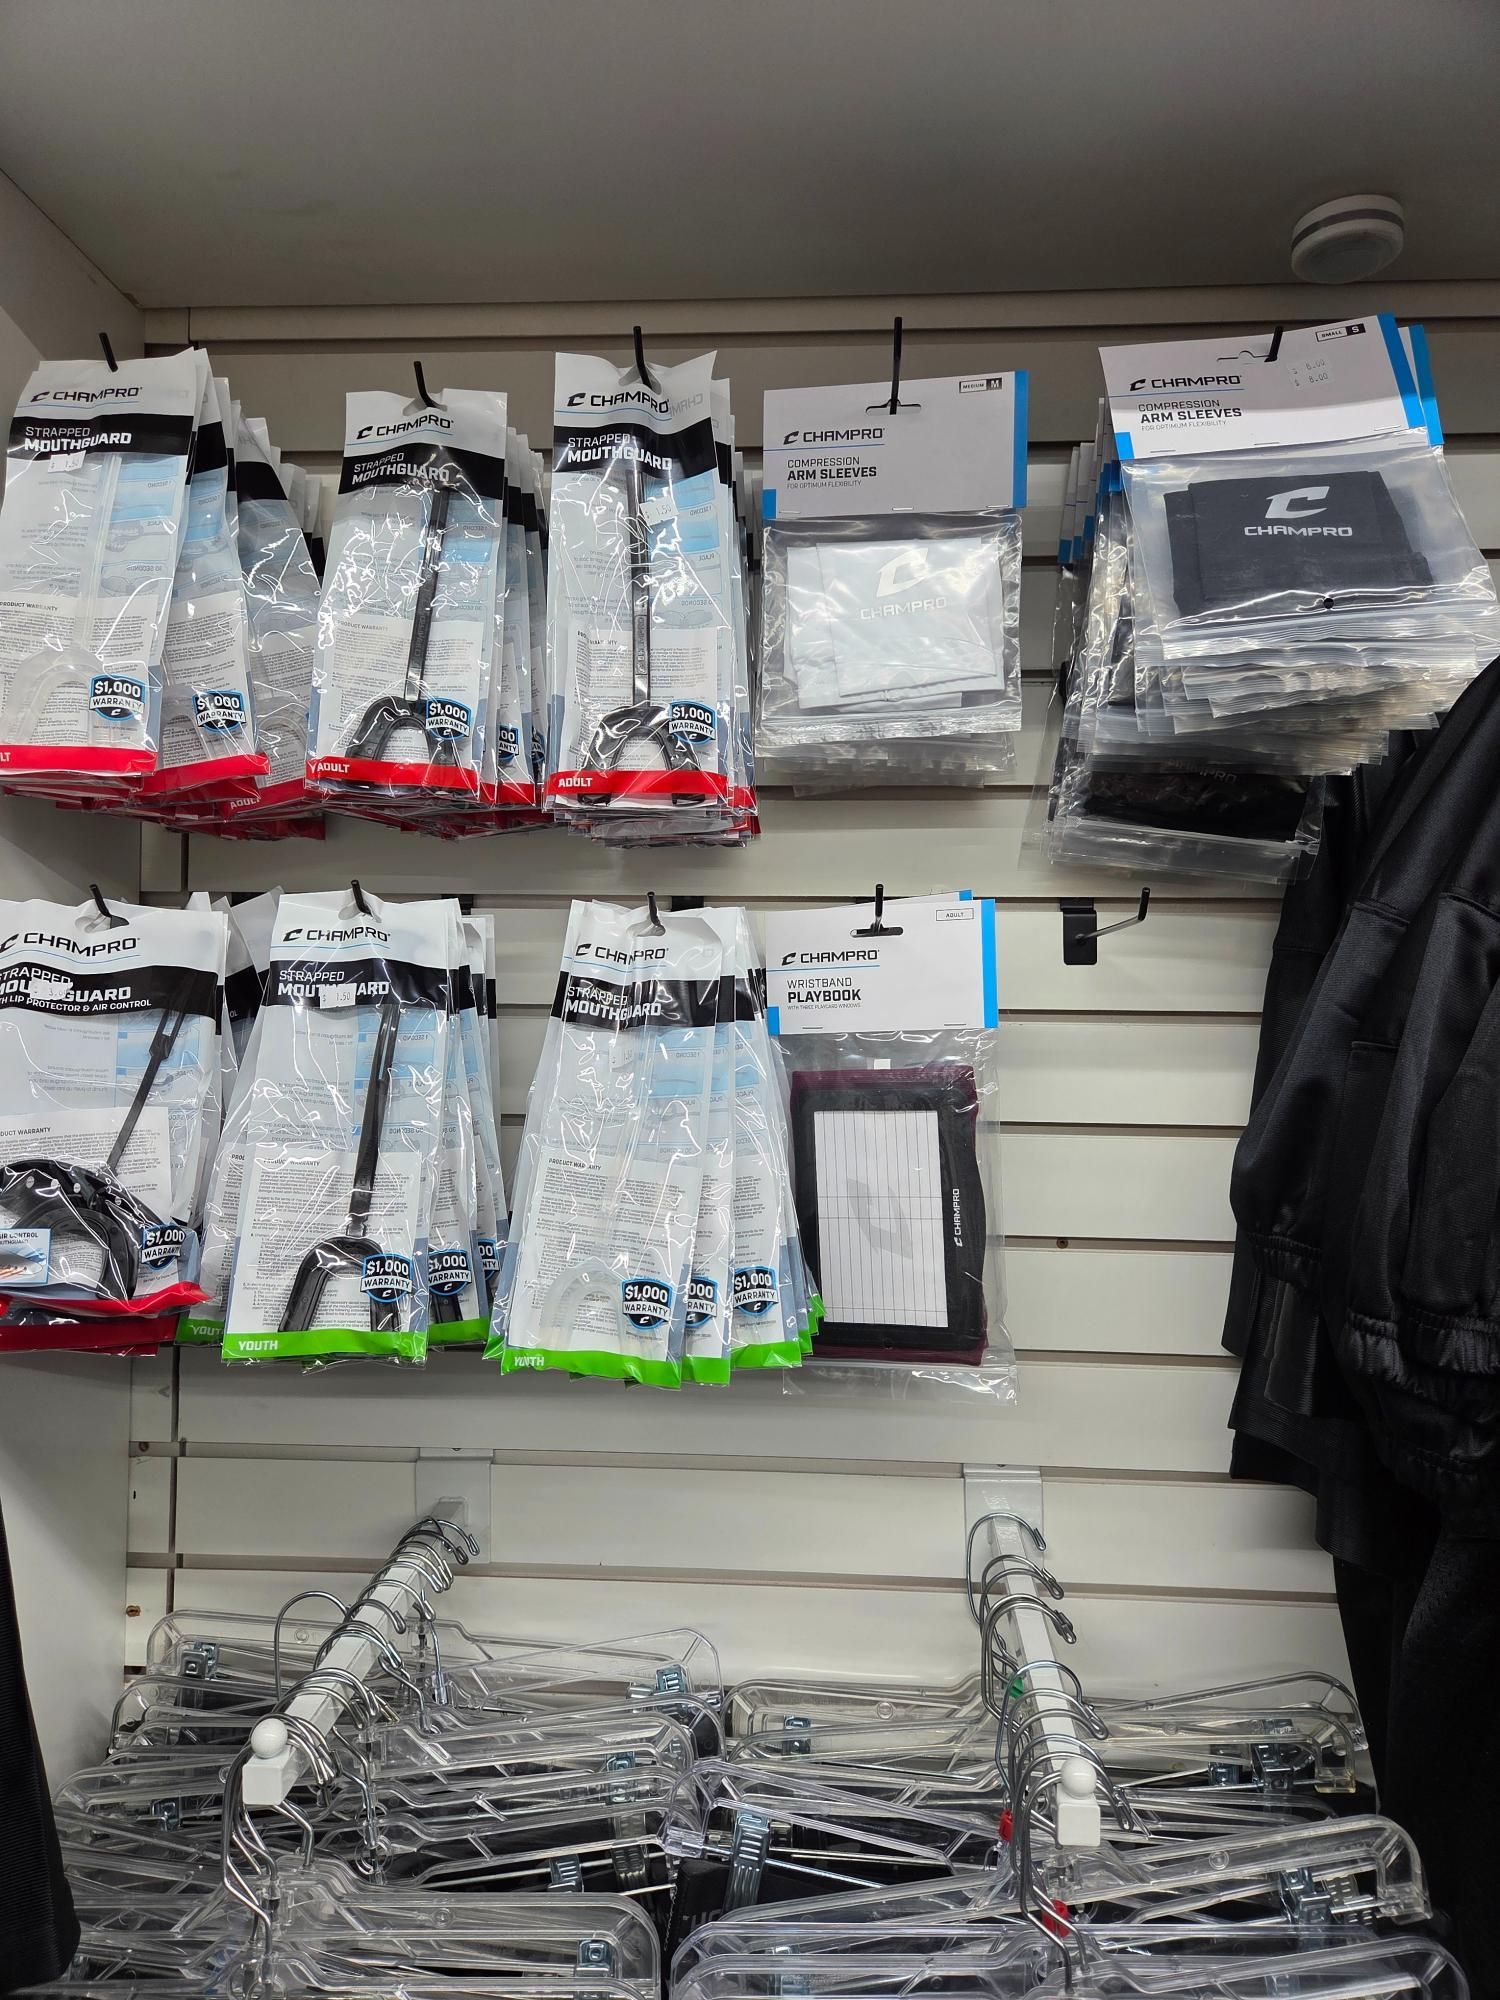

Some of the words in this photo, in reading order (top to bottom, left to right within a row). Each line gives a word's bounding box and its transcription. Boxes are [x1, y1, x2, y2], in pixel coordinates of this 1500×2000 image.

[1321, 330, 1343, 338] SMALL
[990, 380, 999, 388] M
[1151, 375, 1241, 389] CHAMPRO
[52, 387, 139, 402] CHAMPRO
[590, 391, 669, 414] CHAMPRO
[1138, 400, 1220, 412] COMPRESSION
[1140, 411, 1174, 424] ARM
[1177, 408, 1242, 420] SLEEVES
[25, 426, 91, 438] STRAPPED
[376, 414, 451, 436] CHAMPRO
[1156, 422, 1186, 430] OPTIMUM
[1188, 420, 1226, 428] FLEXIBILITY
[24, 431, 132, 452] MOUTHGUARD
[568, 433, 631, 448] STRAPPED
[803, 428, 884, 443] CHAMPRO
[354, 452, 405, 473] STRAPPED
[568, 446, 673, 470] MOUTHGUARD
[787, 456, 860, 468] COMPRESSION
[352, 463, 450, 485] MOUTHGUARD
[787, 469, 816, 481] ARM
[820, 466, 877, 479] SLEEVES
[799, 481, 827, 489] OPTIMUM
[828, 480, 861, 488] FLEXIBILITY
[656, 504, 671, 516] 1.50
[1244, 525, 1353, 537] CHAMPRO
[860, 596, 947, 620] CHAMPRO
[94, 680, 141, 698] $1,000
[92, 698, 142, 710] WARRANTY
[198, 696, 240, 710] $1,000
[198, 712, 244, 723] WARRANTY
[429, 702, 468, 722] $1,000
[672, 706, 712, 724] $1,000
[428, 718, 469, 734] WARRANTY
[671, 722, 714, 737] WARRANTY
[317, 762, 350, 774] ADULT
[558, 777, 592, 788] ADULT
[306, 926, 388, 942] CHAMPRO
[24, 932, 136, 957] CHAMPRO
[800, 950, 878, 963] CHAMPRO
[280, 970, 345, 982] STRAPPED
[787, 977, 852, 989] WRISTBAND
[336, 991, 350, 1001] 1.50
[568, 986, 628, 1005] STRAPPED
[788, 989, 861, 1003] PLAYBOOK
[26, 998, 80, 1012] PROTECTOR
[92, 1003, 108, 1012] AIR
[110, 1000, 152, 1010] CONTROL
[565, 1000, 661, 1021] MOUTHGUARD
[18, 1127, 51, 1136] WARRANTY
[549, 1158, 572, 1167] PRODUCT
[574, 1162, 601, 1171] WARANTY
[954, 1188, 962, 1235] CHAMPRO
[146, 1230, 185, 1245] $1,000
[366, 1260, 409, 1276] $1,000
[363, 1278, 411, 1290] WARRANTY
[734, 1274, 772, 1291] $1,000
[625, 1284, 668, 1303] $1,000
[734, 1291, 775, 1304] WARRANTY
[624, 1303, 668, 1316] WARRANTY
[238, 1340, 278, 1350] YOUTH
